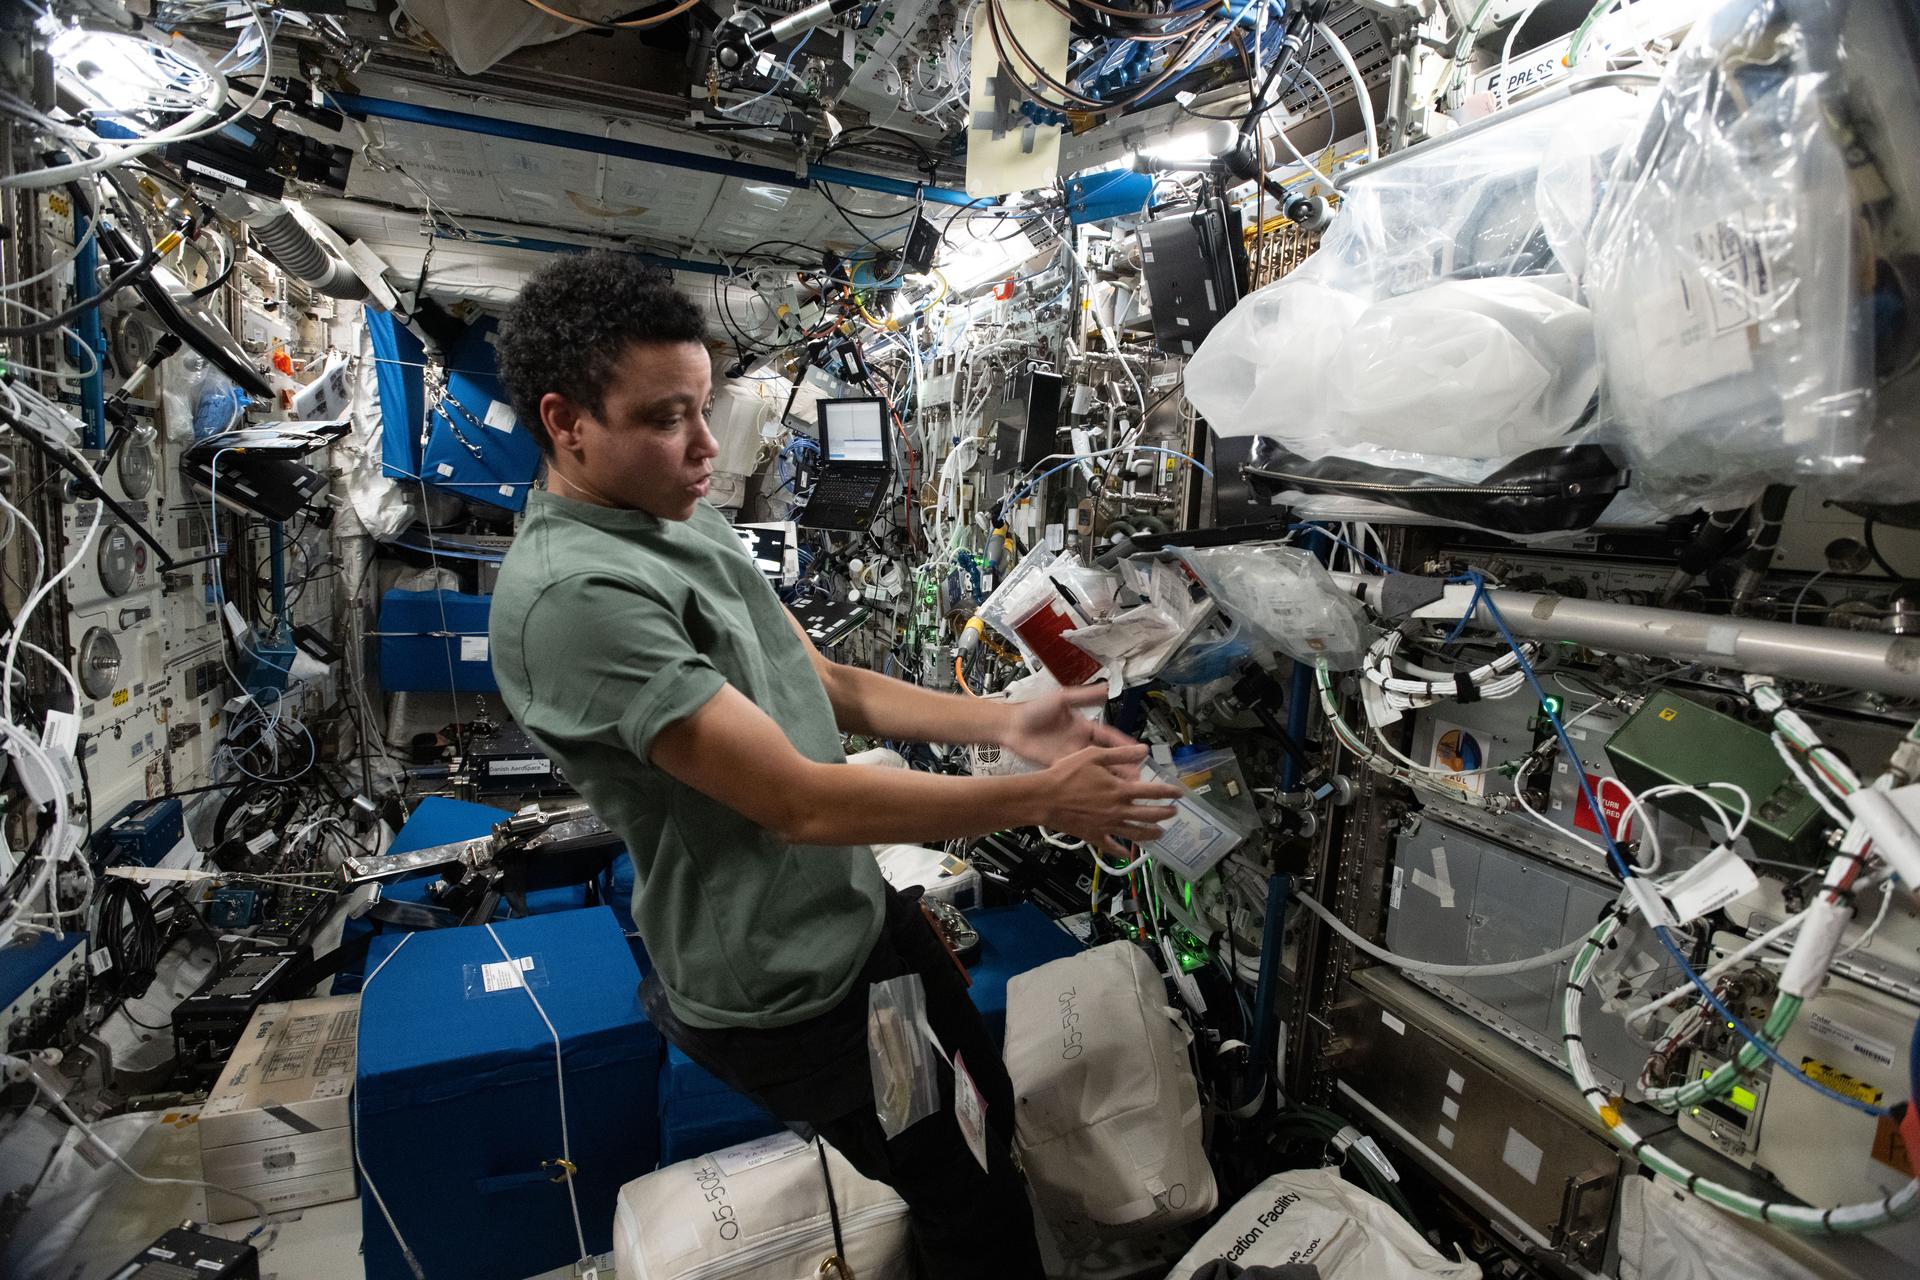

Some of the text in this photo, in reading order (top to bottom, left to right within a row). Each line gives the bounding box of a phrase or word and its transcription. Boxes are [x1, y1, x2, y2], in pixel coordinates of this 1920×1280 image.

[1488, 59, 1554, 90] EPRESS
[490, 764, 542, 774] Danish Aerospace
[1257, 1191, 1302, 1228] Facility
[1302, 1237, 1322, 1260] TOOL
